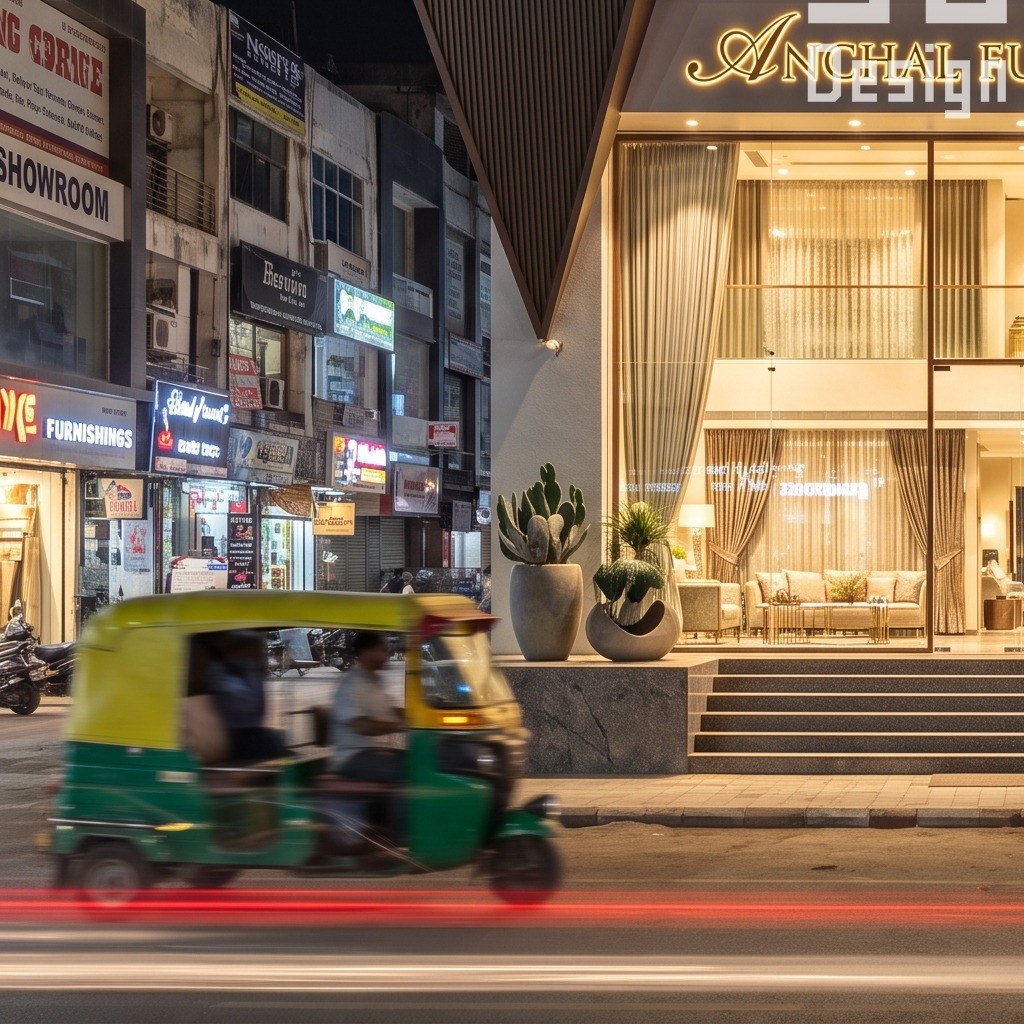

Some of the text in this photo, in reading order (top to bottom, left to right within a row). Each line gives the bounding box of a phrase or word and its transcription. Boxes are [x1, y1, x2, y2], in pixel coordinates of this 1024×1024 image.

[685, 10, 961, 84] ANCHAL
[0, 145, 109, 222] SHOWROOM
[46, 417, 133, 449] FURNISHINGS
